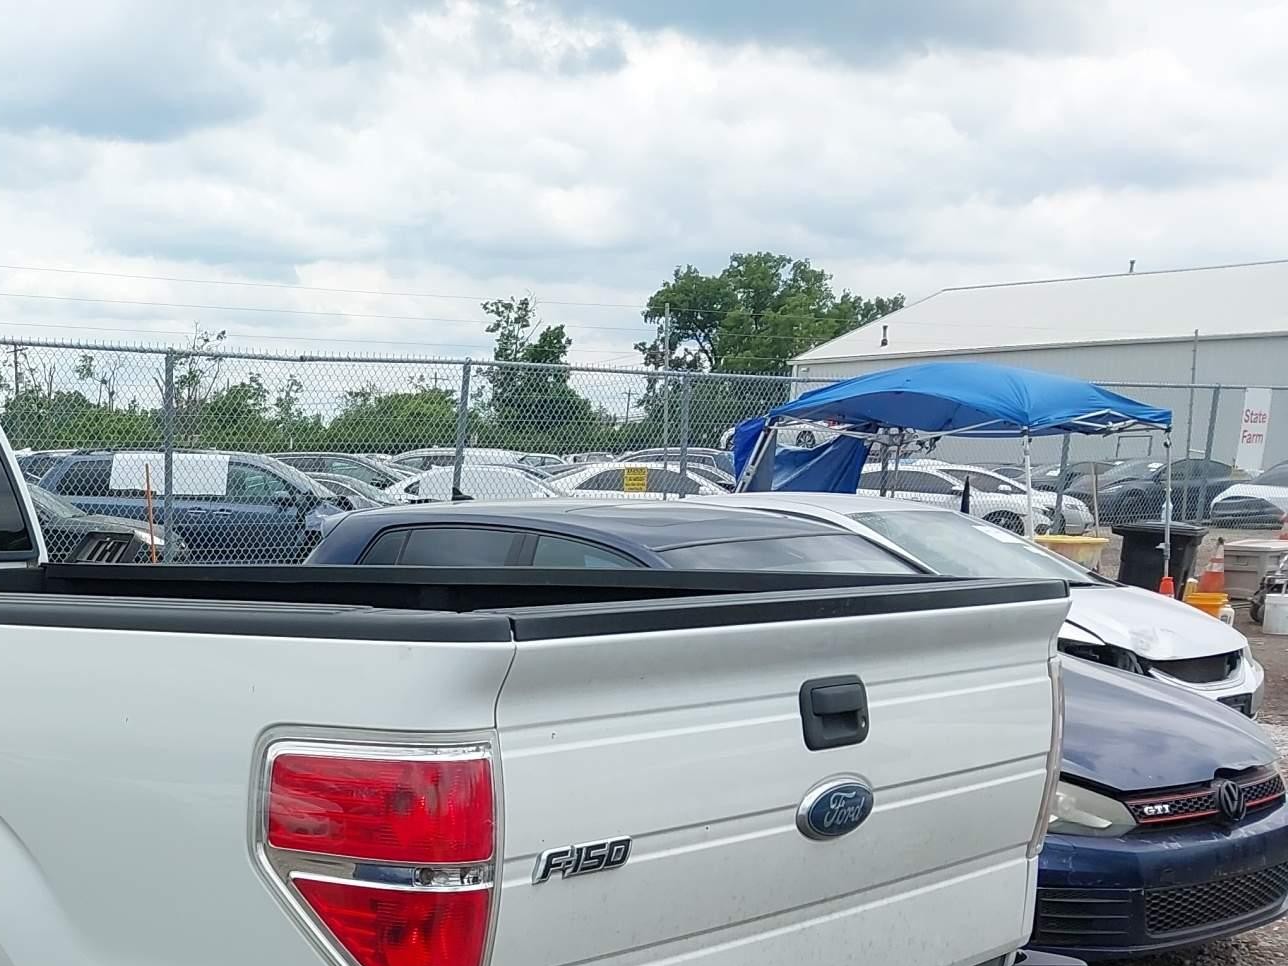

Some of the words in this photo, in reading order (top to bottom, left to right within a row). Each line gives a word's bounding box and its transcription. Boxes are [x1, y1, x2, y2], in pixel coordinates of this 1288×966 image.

[1244, 409, 1267, 424] State
[1242, 430, 1263, 444] Farm
[824, 791, 865, 828] Ford
[1144, 804, 1170, 815] GTI
[532, 836, 632, 885] F-150
